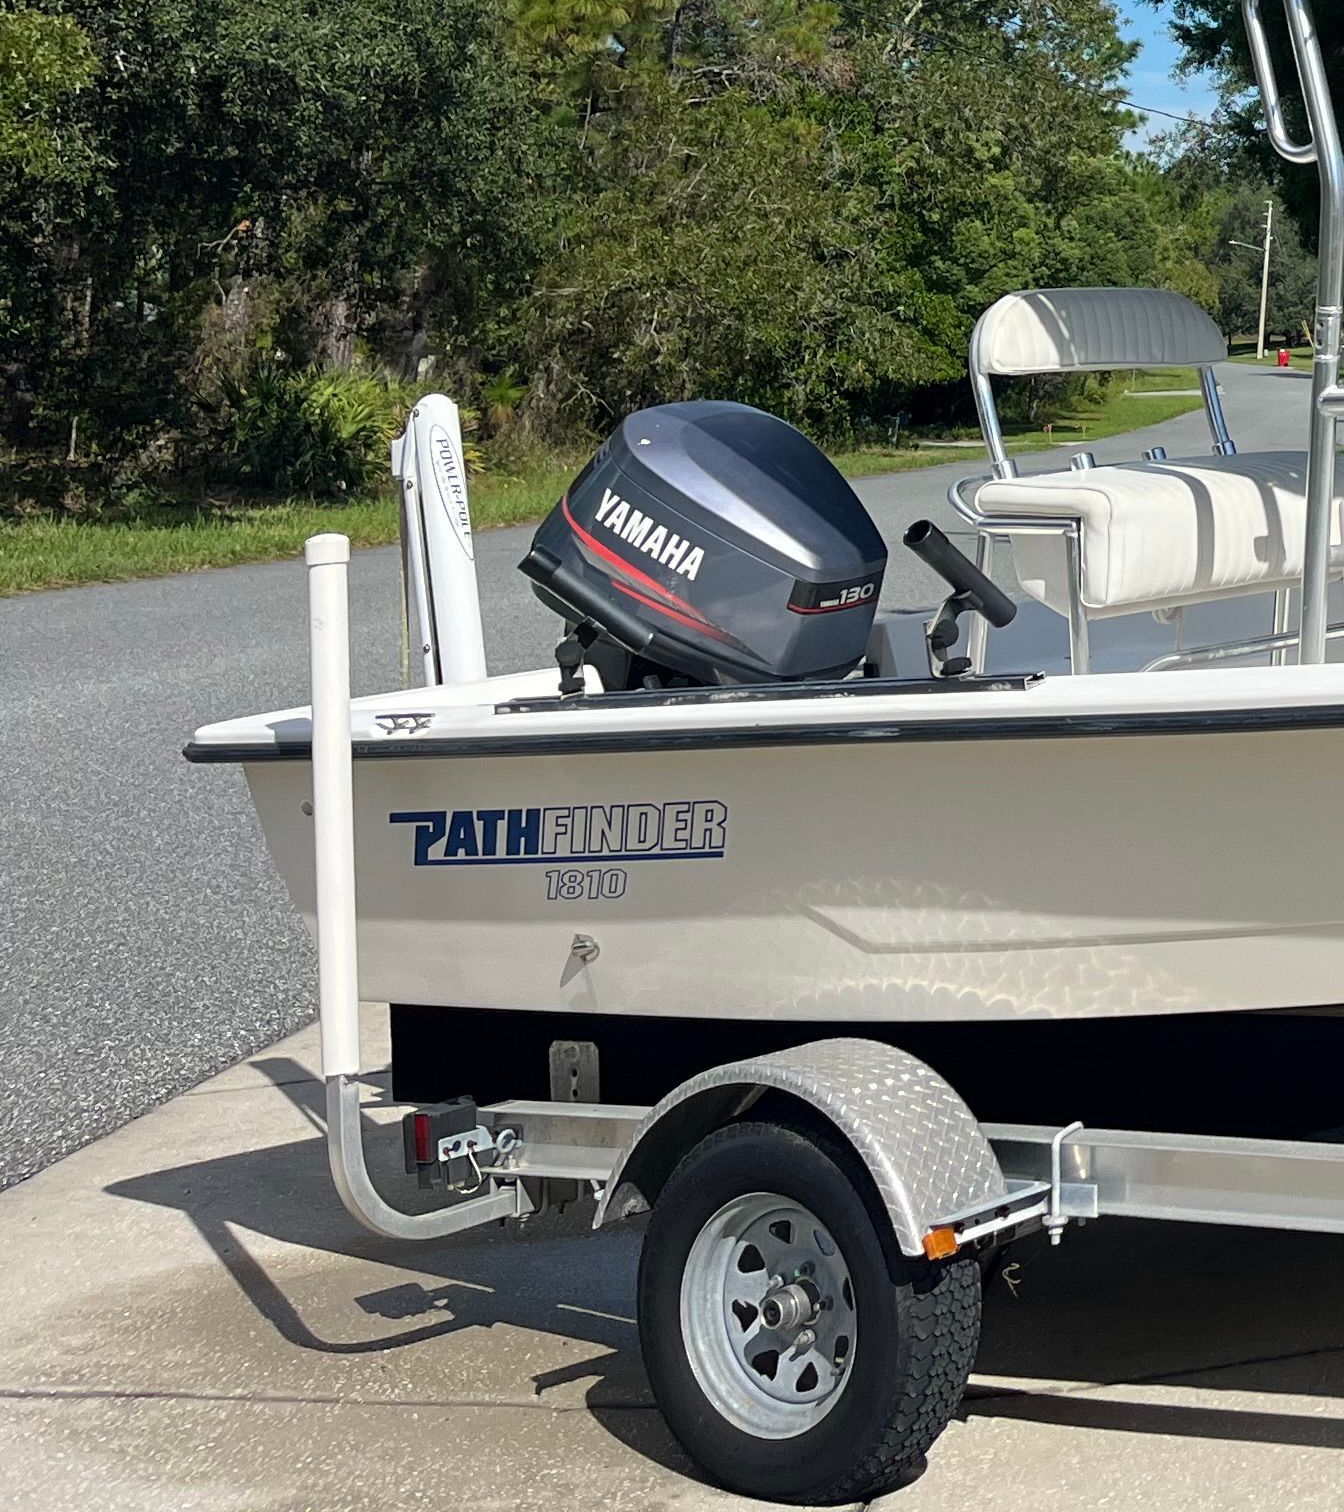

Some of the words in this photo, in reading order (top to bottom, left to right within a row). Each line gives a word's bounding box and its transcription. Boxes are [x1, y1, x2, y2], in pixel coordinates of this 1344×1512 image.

[595, 488, 705, 581] YAMAHA
[840, 583, 875, 605] 130
[389, 800, 728, 866] PATHFINDER
[545, 868, 627, 900] 1810
